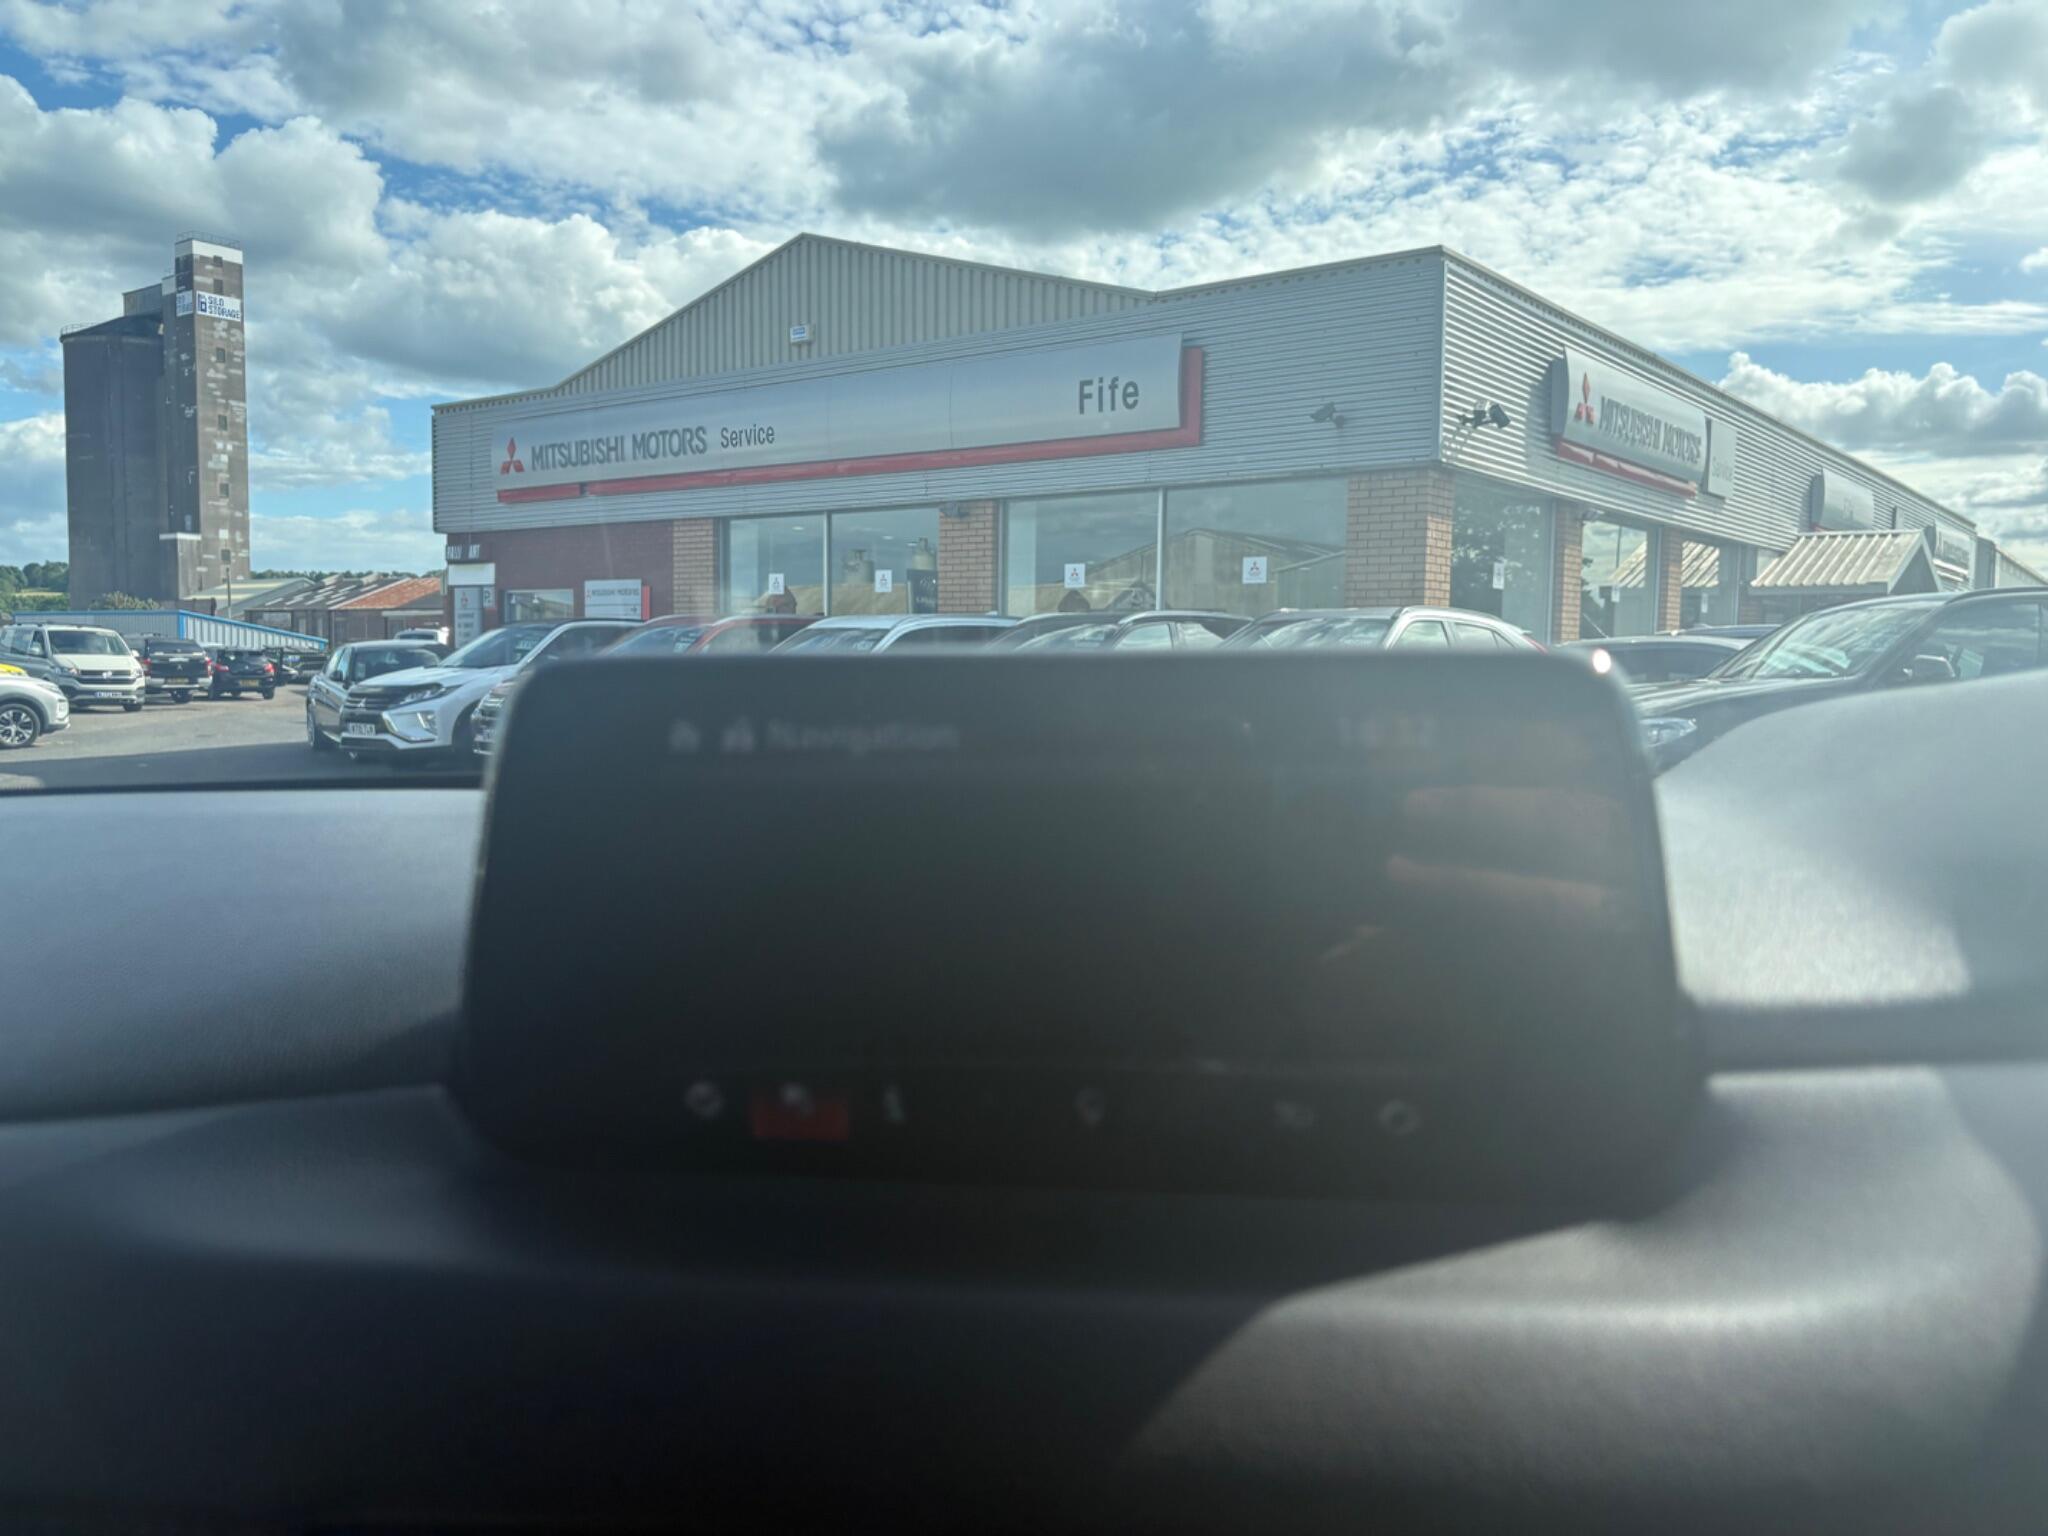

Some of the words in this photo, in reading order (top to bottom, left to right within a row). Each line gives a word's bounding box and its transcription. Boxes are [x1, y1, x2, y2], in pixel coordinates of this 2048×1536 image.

[207, 304, 241, 319] STORAGE
[1079, 375, 1140, 415] Fife
[1598, 395, 1661, 450] MITSUBISHI
[531, 436, 625, 472] MITSUBISHI
[631, 425, 708, 461] MOTORS
[720, 423, 776, 449] Service
